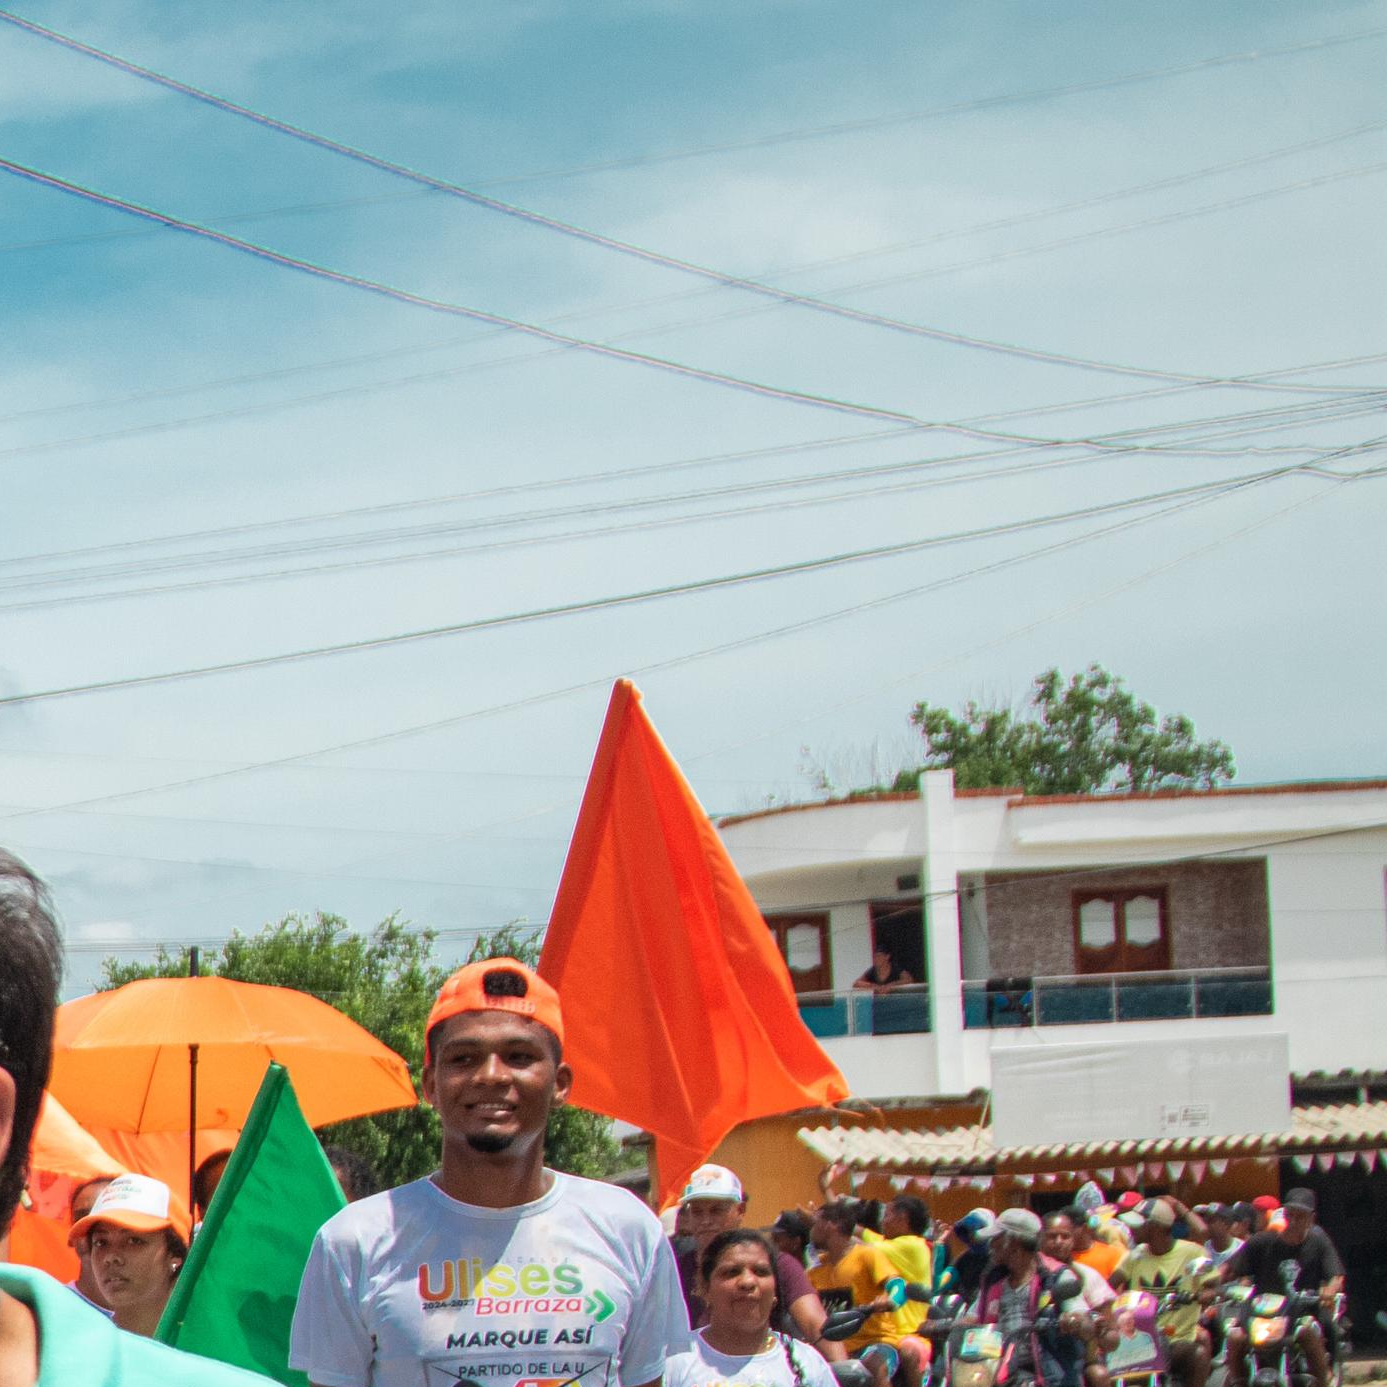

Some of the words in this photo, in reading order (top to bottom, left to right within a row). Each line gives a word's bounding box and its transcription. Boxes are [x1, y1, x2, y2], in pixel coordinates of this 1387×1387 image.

[418, 1257, 584, 1301] Ulises
[476, 1296, 583, 1316] Barraza
[446, 1328, 549, 1350] MARQUE
[554, 1324, 594, 1345] ASÍ
[458, 1363, 524, 1378] PARTIDO
[528, 1363, 547, 1375] DE
[552, 1362, 571, 1374] LA
[575, 1362, 585, 1374] U
